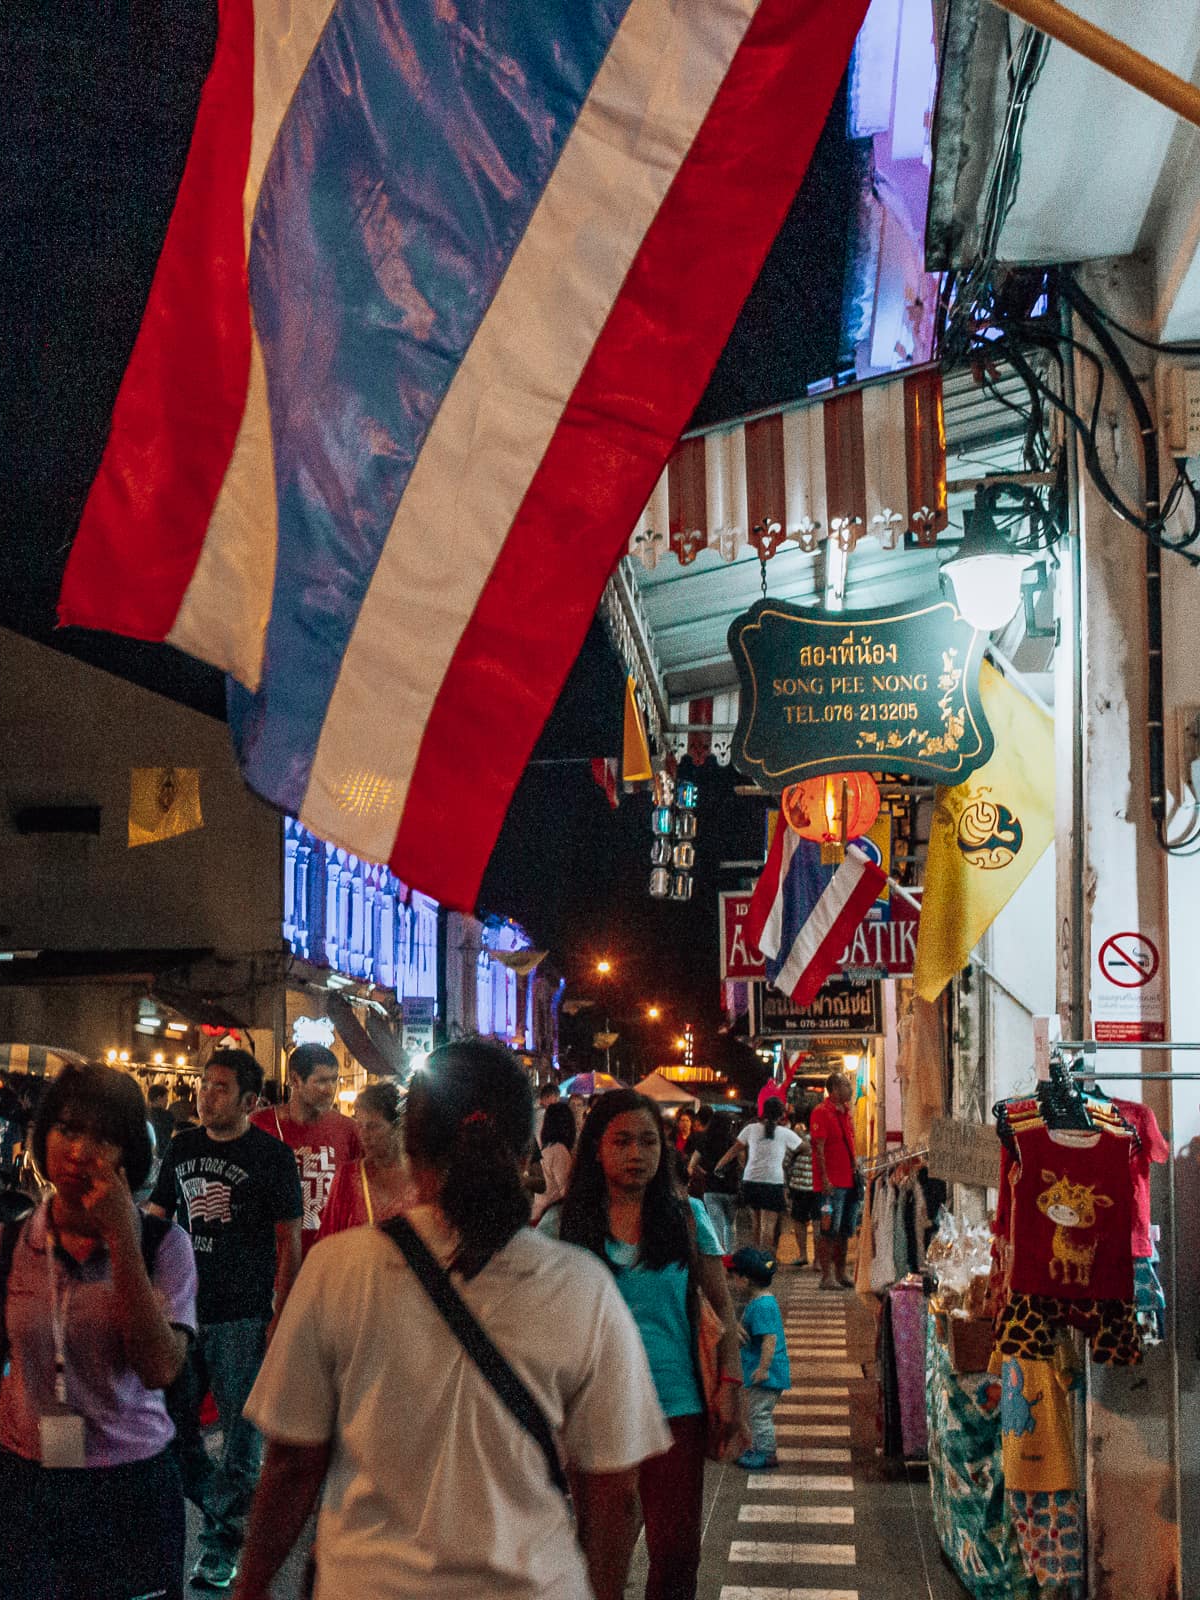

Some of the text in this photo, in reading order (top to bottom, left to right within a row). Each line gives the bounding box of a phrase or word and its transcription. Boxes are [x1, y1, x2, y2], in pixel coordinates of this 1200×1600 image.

[800, 631, 897, 666] สองพี่น้อง
[773, 674, 928, 696] SONG PEE NONG
[836, 921, 917, 965] ATIK
[175, 1157, 249, 1185] NEW YORK CITY
[194, 1236, 214, 1252] USA
